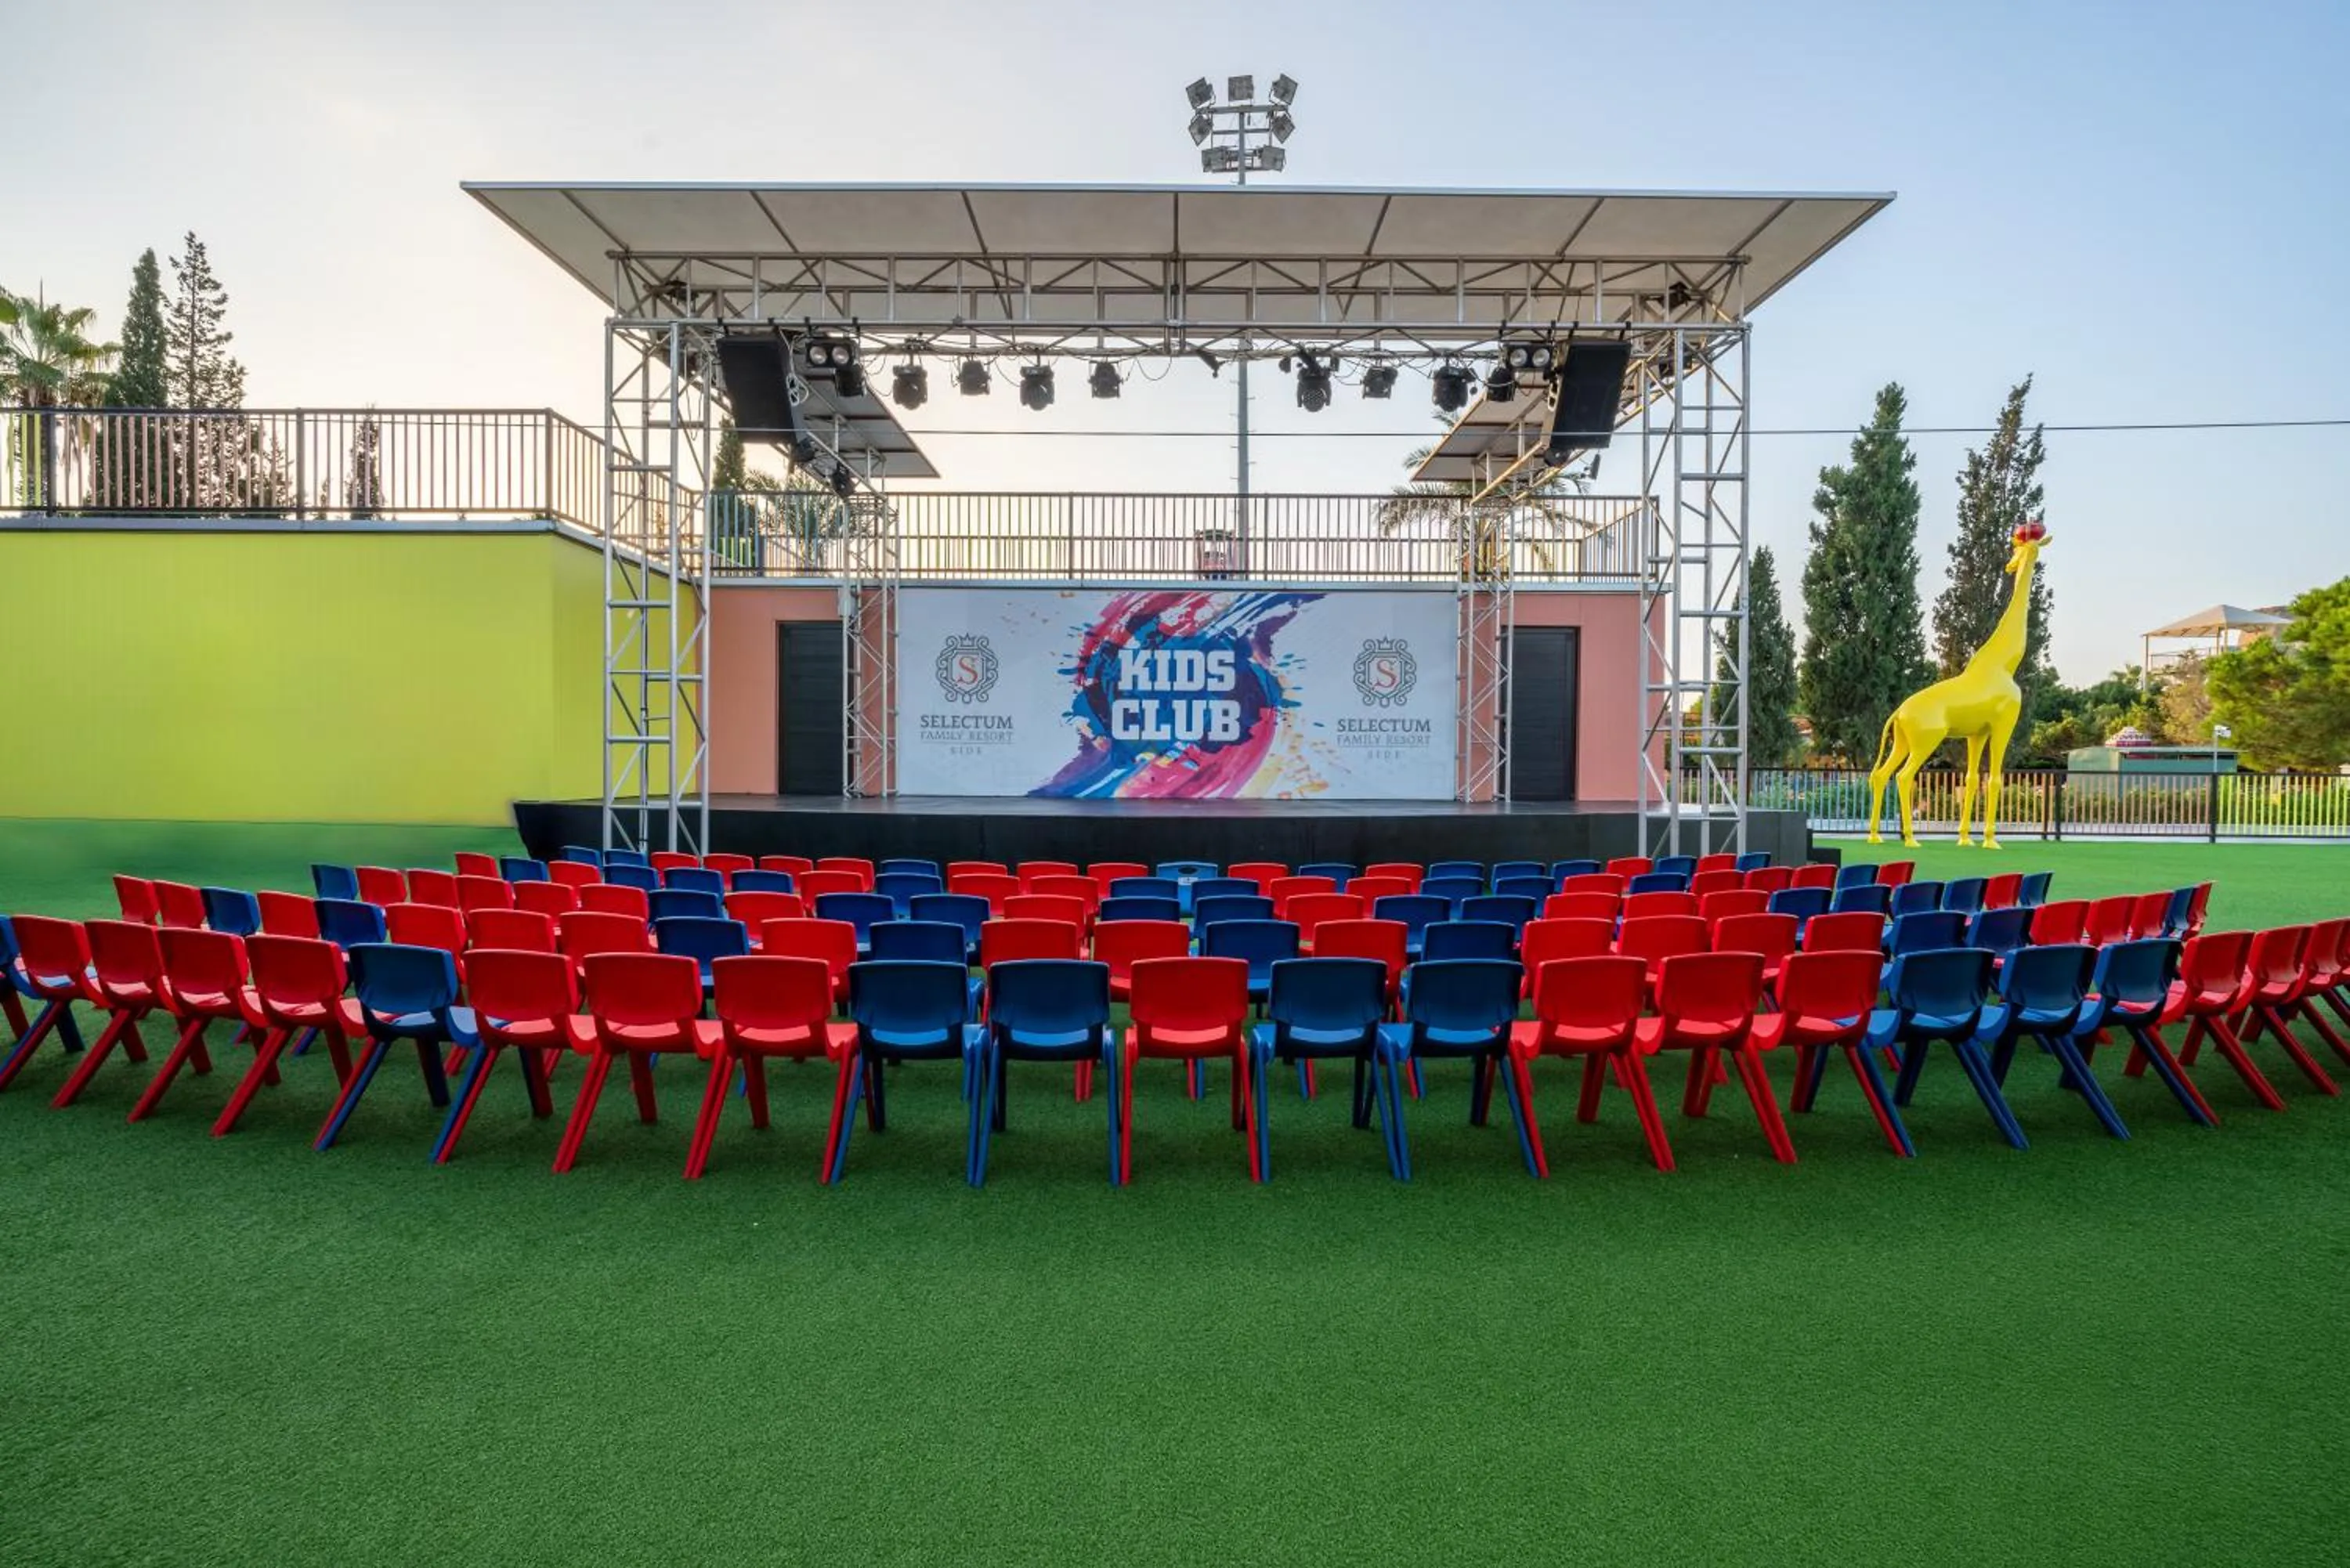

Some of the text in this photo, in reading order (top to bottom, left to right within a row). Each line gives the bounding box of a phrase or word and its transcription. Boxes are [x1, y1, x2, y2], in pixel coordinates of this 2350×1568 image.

[957, 656, 978, 685] S
[1118, 649, 1235, 692] KIDS
[1373, 659, 1397, 688] S
[920, 714, 1013, 729] SELECTUM
[1112, 699, 1241, 742] CLUB
[1337, 718, 1431, 732] SELECTUM
[920, 731, 1013, 741] FAMILY RESORT
[1336, 735, 1430, 745] FAMILY RESORT
